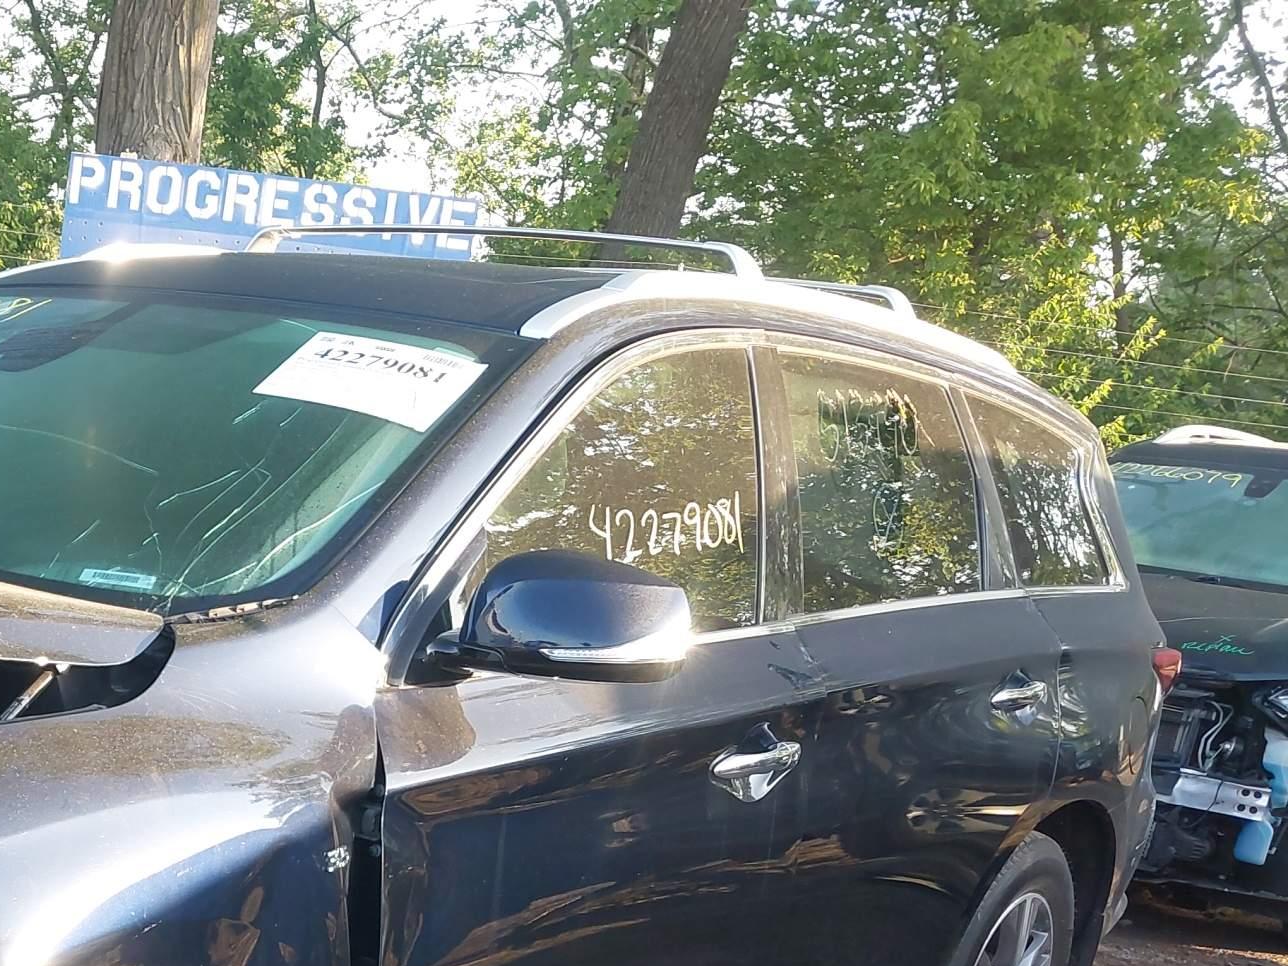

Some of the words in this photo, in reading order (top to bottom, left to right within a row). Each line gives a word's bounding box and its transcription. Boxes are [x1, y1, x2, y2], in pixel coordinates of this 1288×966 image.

[68, 157, 479, 250] PROGRESSIVE
[314, 347, 449, 384] 42279081
[588, 490, 745, 560] 42279081
